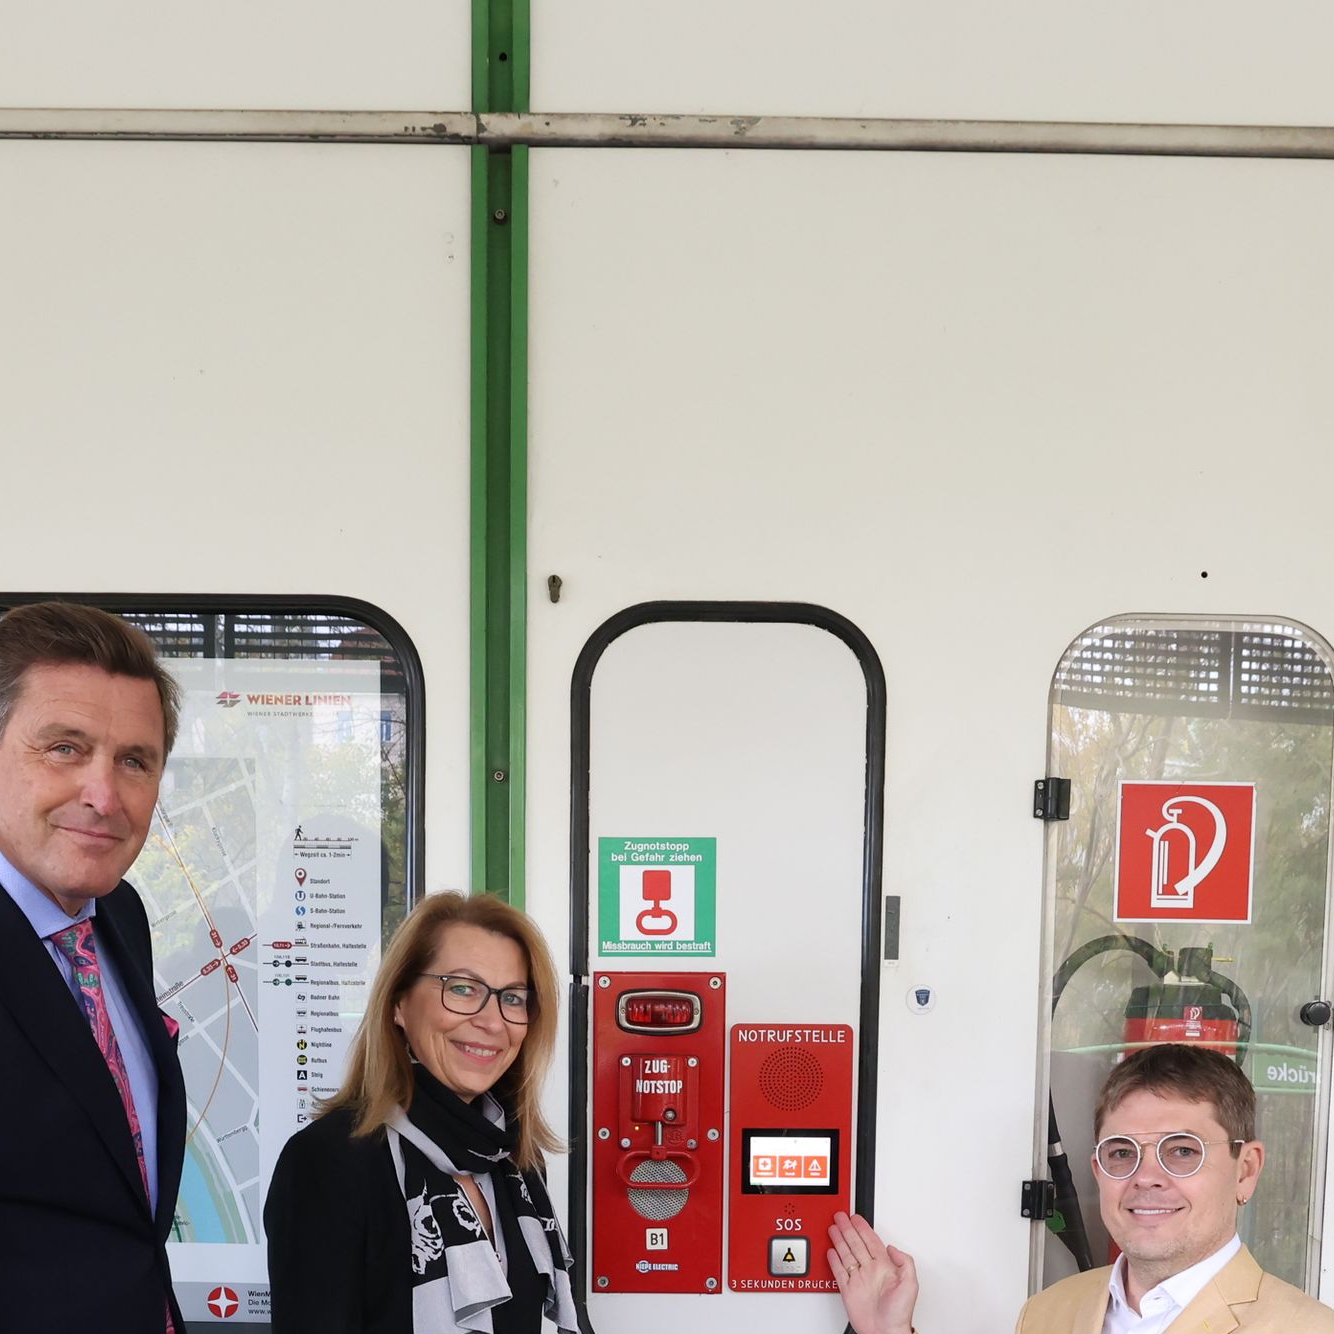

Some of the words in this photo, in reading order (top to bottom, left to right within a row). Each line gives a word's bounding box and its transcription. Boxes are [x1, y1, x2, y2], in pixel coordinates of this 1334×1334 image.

[247, 694, 302, 706] WIENER
[305, 694, 351, 706] LINIEN
[624, 841, 690, 852] Zugnotstopp
[611, 852, 627, 862] bei
[631, 852, 665, 862] Gefahr
[669, 852, 703, 862] ziehen
[602, 941, 652, 952] Missbrauch
[654, 941, 673, 951] wird
[676, 941, 711, 951] bestraft
[738, 1029, 845, 1043] NOTRUFSTELLE
[644, 1060, 671, 1074] ZUG-
[636, 1080, 683, 1094] NOTSTOP
[775, 1218, 802, 1231] SOS
[650, 1233, 664, 1246] B1
[652, 1263, 679, 1271] ELECTRIC
[731, 1279, 737, 1289] 3
[740, 1279, 795, 1289] SEKUNDEN
[798, 1279, 838, 1289] DRÜCKE
